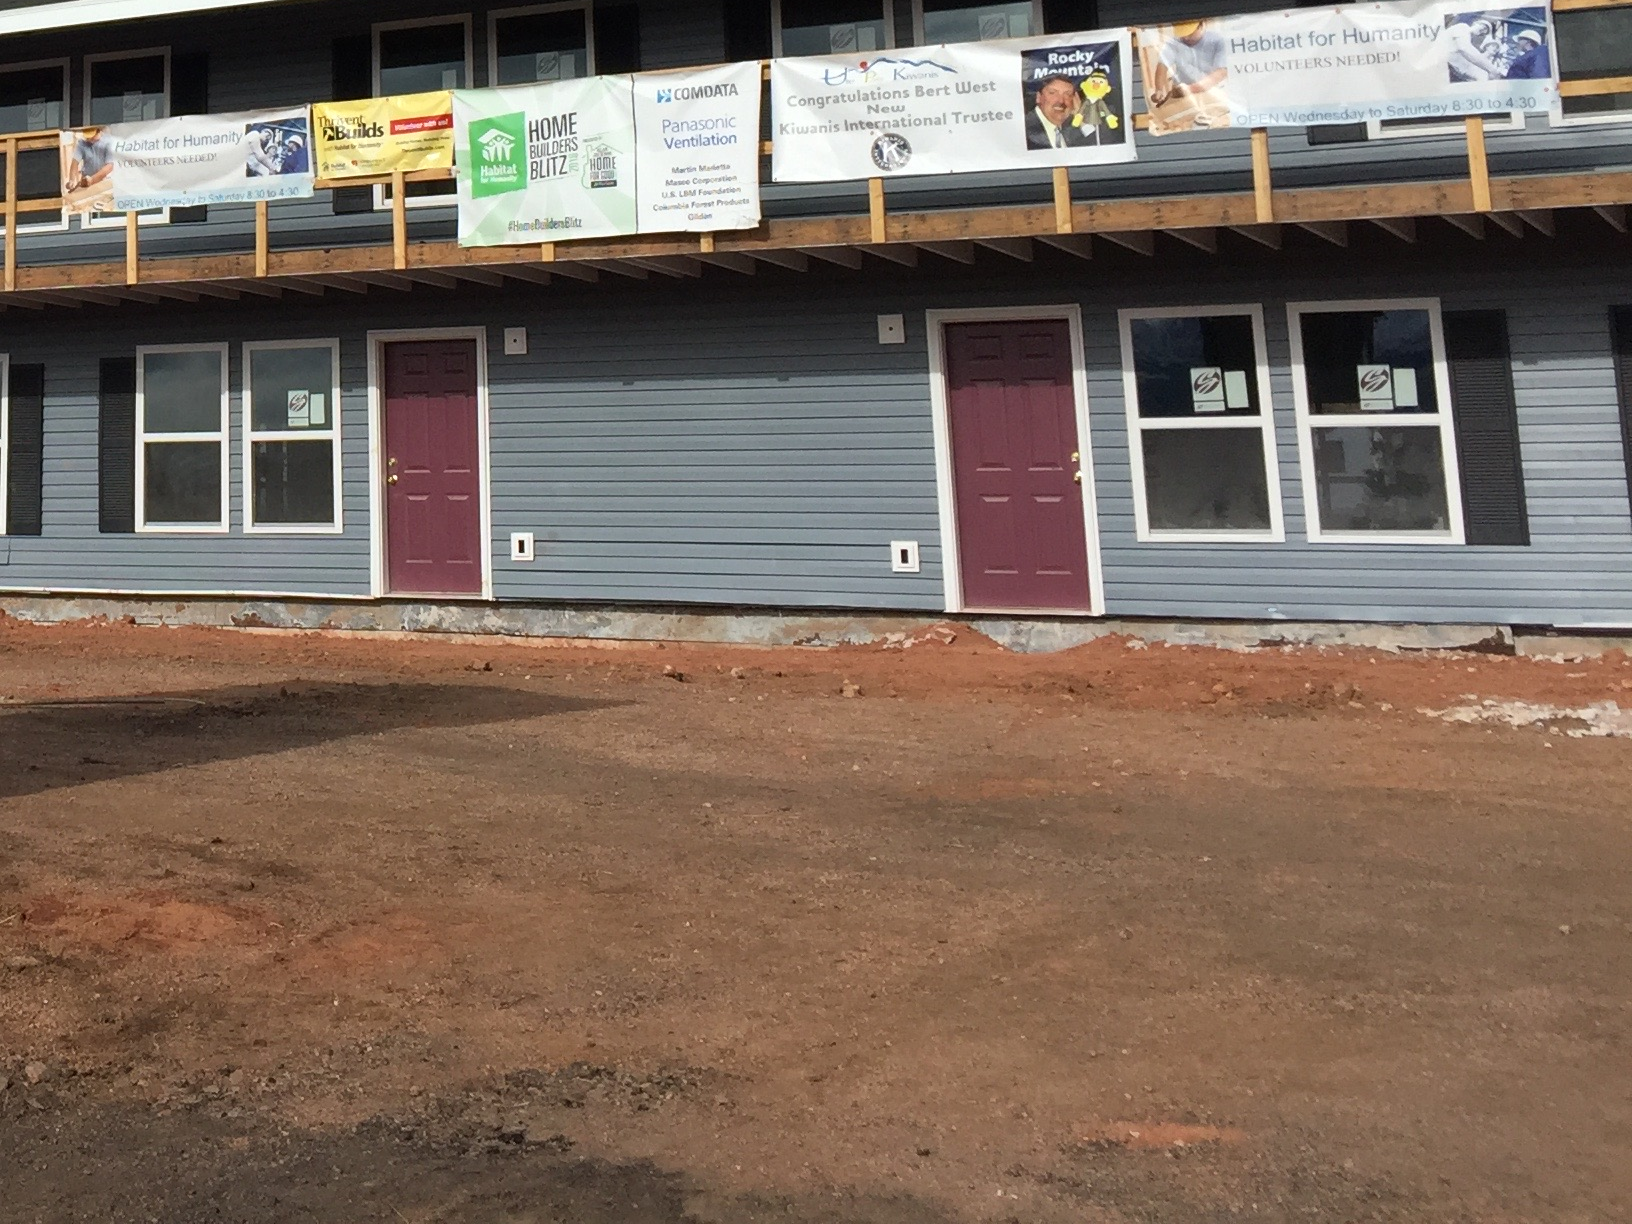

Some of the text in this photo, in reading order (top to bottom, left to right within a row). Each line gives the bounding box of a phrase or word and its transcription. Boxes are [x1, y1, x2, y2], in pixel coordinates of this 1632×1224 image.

[1230, 24, 1441, 54] Habitat for Humanity
[1048, 50, 1094, 65] Rocky
[1234, 51, 1401, 74] VOLUNTEERS NEEDED!
[674, 83, 738, 100] COMDATA
[787, 80, 997, 109] Congratulations Bert West
[867, 103, 906, 114] New
[1236, 96, 1537, 126] OPEN Wednesday to Saturday 8:30 to 4:30
[318, 115, 363, 128] Thrivent
[529, 112, 577, 143] HOME
[662, 114, 736, 134] Panasonic
[779, 109, 1014, 136] Kiwanis International Trustee
[335, 123, 384, 140] Builds
[115, 131, 243, 153] Habitat for Humanity
[529, 137, 578, 160] BUILDERS
[664, 133, 737, 149] Ventilation
[118, 152, 218, 169] VOLUNTEERS NEEDED!
[530, 155, 567, 180] BLITZ
[590, 156, 616, 171] HOME
[481, 164, 517, 177] Habitat
[692, 175, 737, 185] Corporation
[699, 187, 741, 196] Foundation
[118, 199, 144, 210] OPEN
